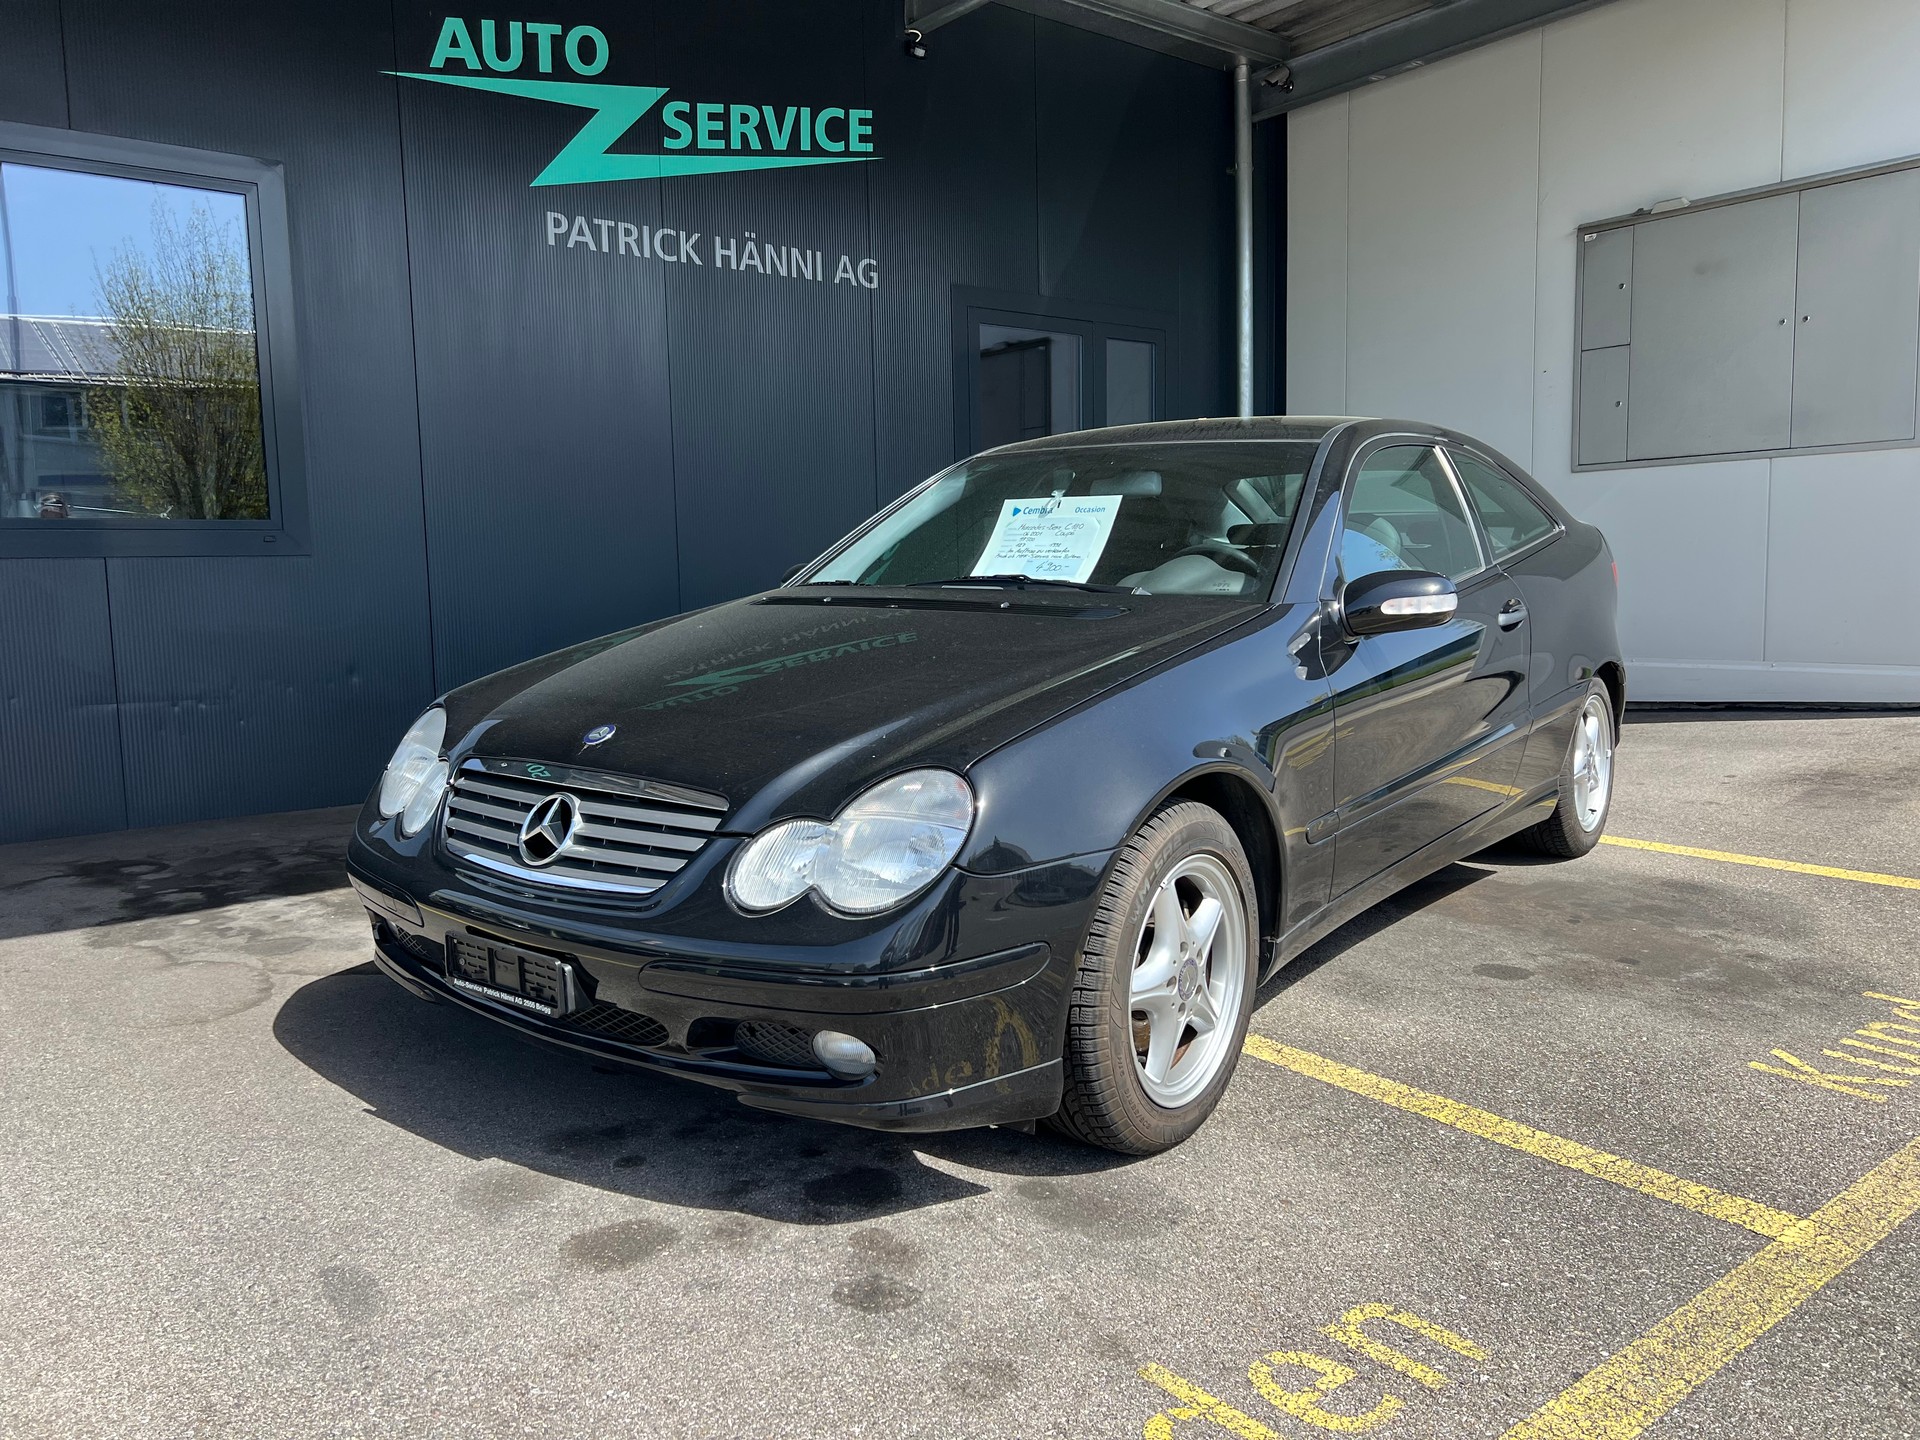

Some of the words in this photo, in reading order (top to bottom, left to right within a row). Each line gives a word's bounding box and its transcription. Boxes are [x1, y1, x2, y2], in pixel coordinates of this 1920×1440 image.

[429, 17, 610, 76] AUTO
[661, 101, 875, 153] SERVICE
[546, 210, 703, 266] PATRICK
[714, 231, 823, 282] HÄNNI
[833, 255, 879, 290] AG
[1074, 506, 1106, 514] Occasion
[453, 978, 483, 993] Auto-Service
[483, 986, 500, 998] Patrick
[514, 996, 523, 1005] AG
